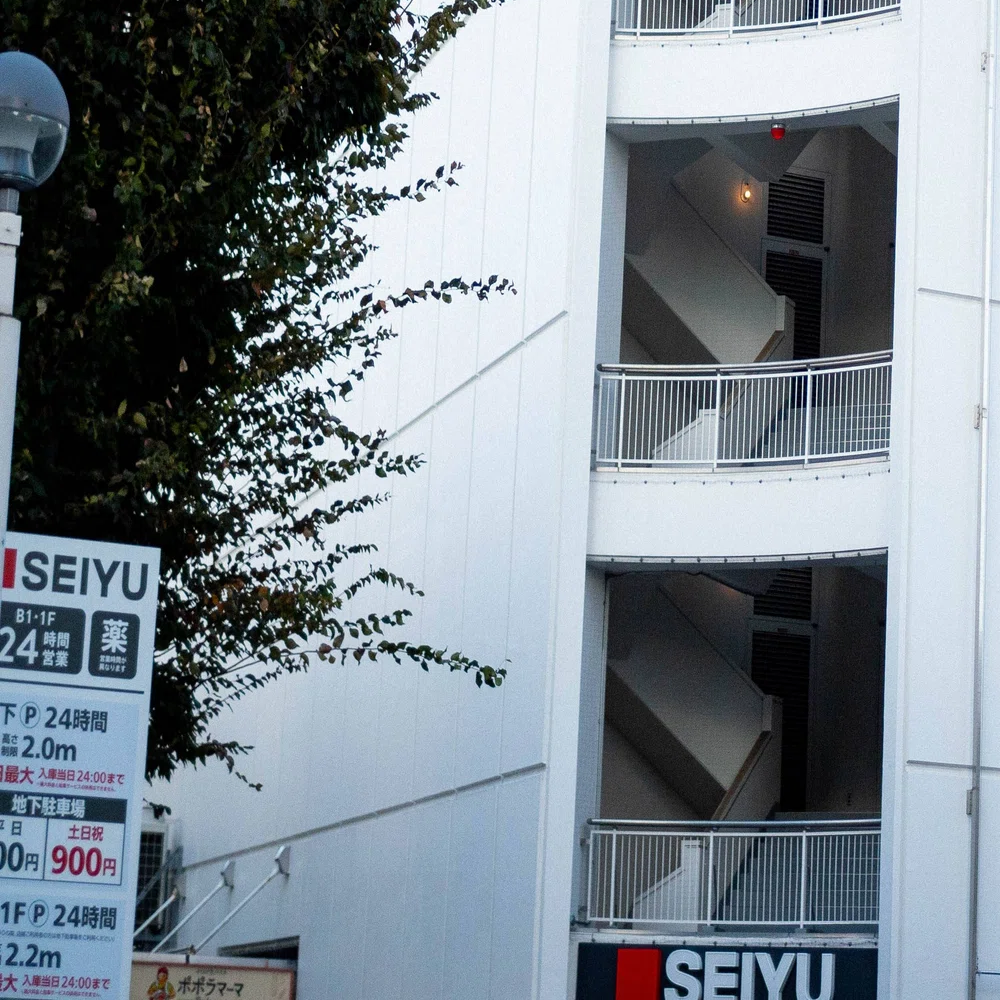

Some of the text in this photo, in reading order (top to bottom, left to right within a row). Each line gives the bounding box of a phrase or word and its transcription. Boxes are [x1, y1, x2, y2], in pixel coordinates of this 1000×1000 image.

[21, 550, 149, 601] SEIYU
[0, 626, 39, 665] 24
[43, 631, 70, 649] 時間
[101, 618, 129, 654] 薬
[42, 649, 69, 668] 営業
[44, 706, 108, 733] 24時間
[2, 733, 19, 745] 高さ
[21, 734, 77, 762] 2.0m
[11, 794, 86, 819] 地下駐車場
[68, 824, 104, 842] 土日祝
[51, 844, 116, 877] 900円
[53, 903, 117, 931] 24時間
[5, 942, 61, 969] 2.2m
[663, 949, 836, 1000] SEIYU
